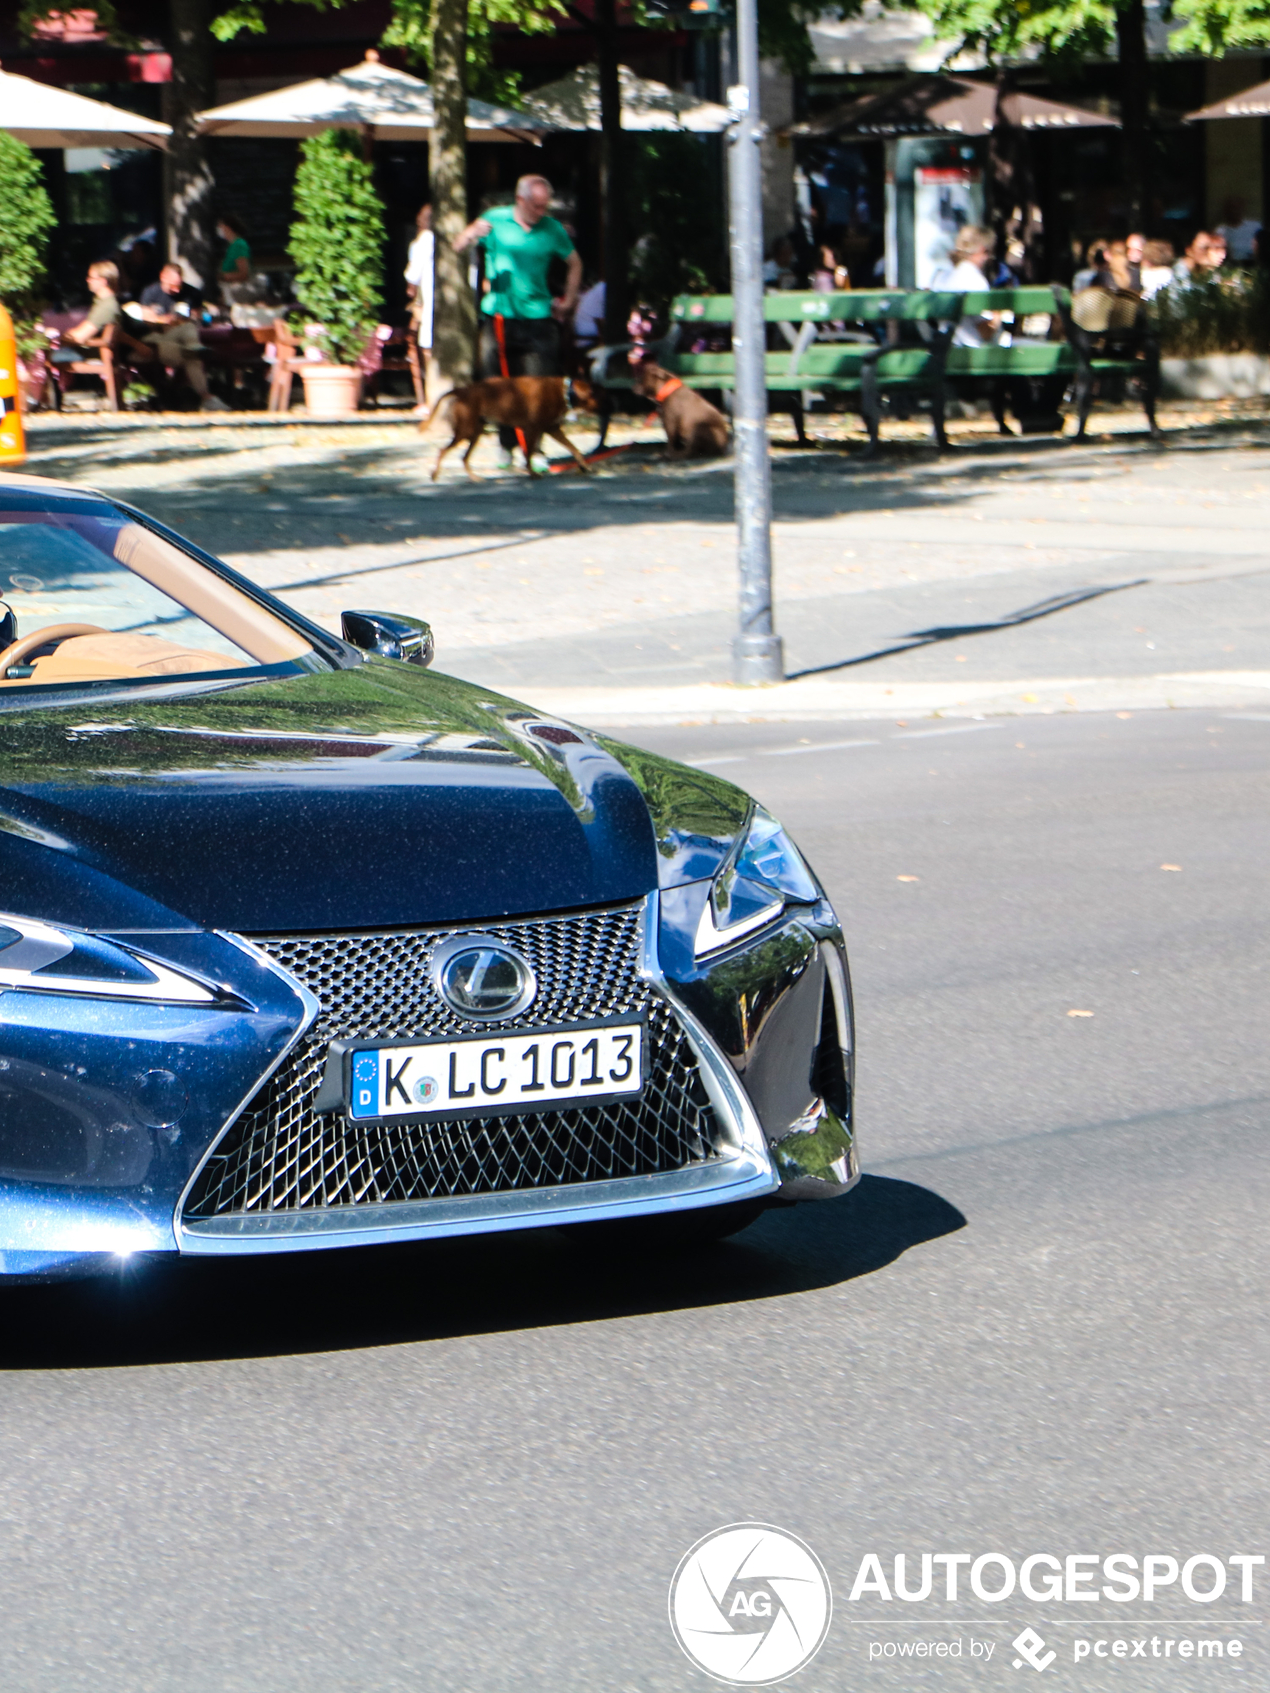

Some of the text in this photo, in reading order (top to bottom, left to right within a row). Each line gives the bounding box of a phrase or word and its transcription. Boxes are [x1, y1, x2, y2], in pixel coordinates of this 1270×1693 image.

[385, 1056, 413, 1106] K
[449, 1047, 507, 1099] LC
[520, 1035, 634, 1092] 1013
[359, 1089, 372, 1106] D
